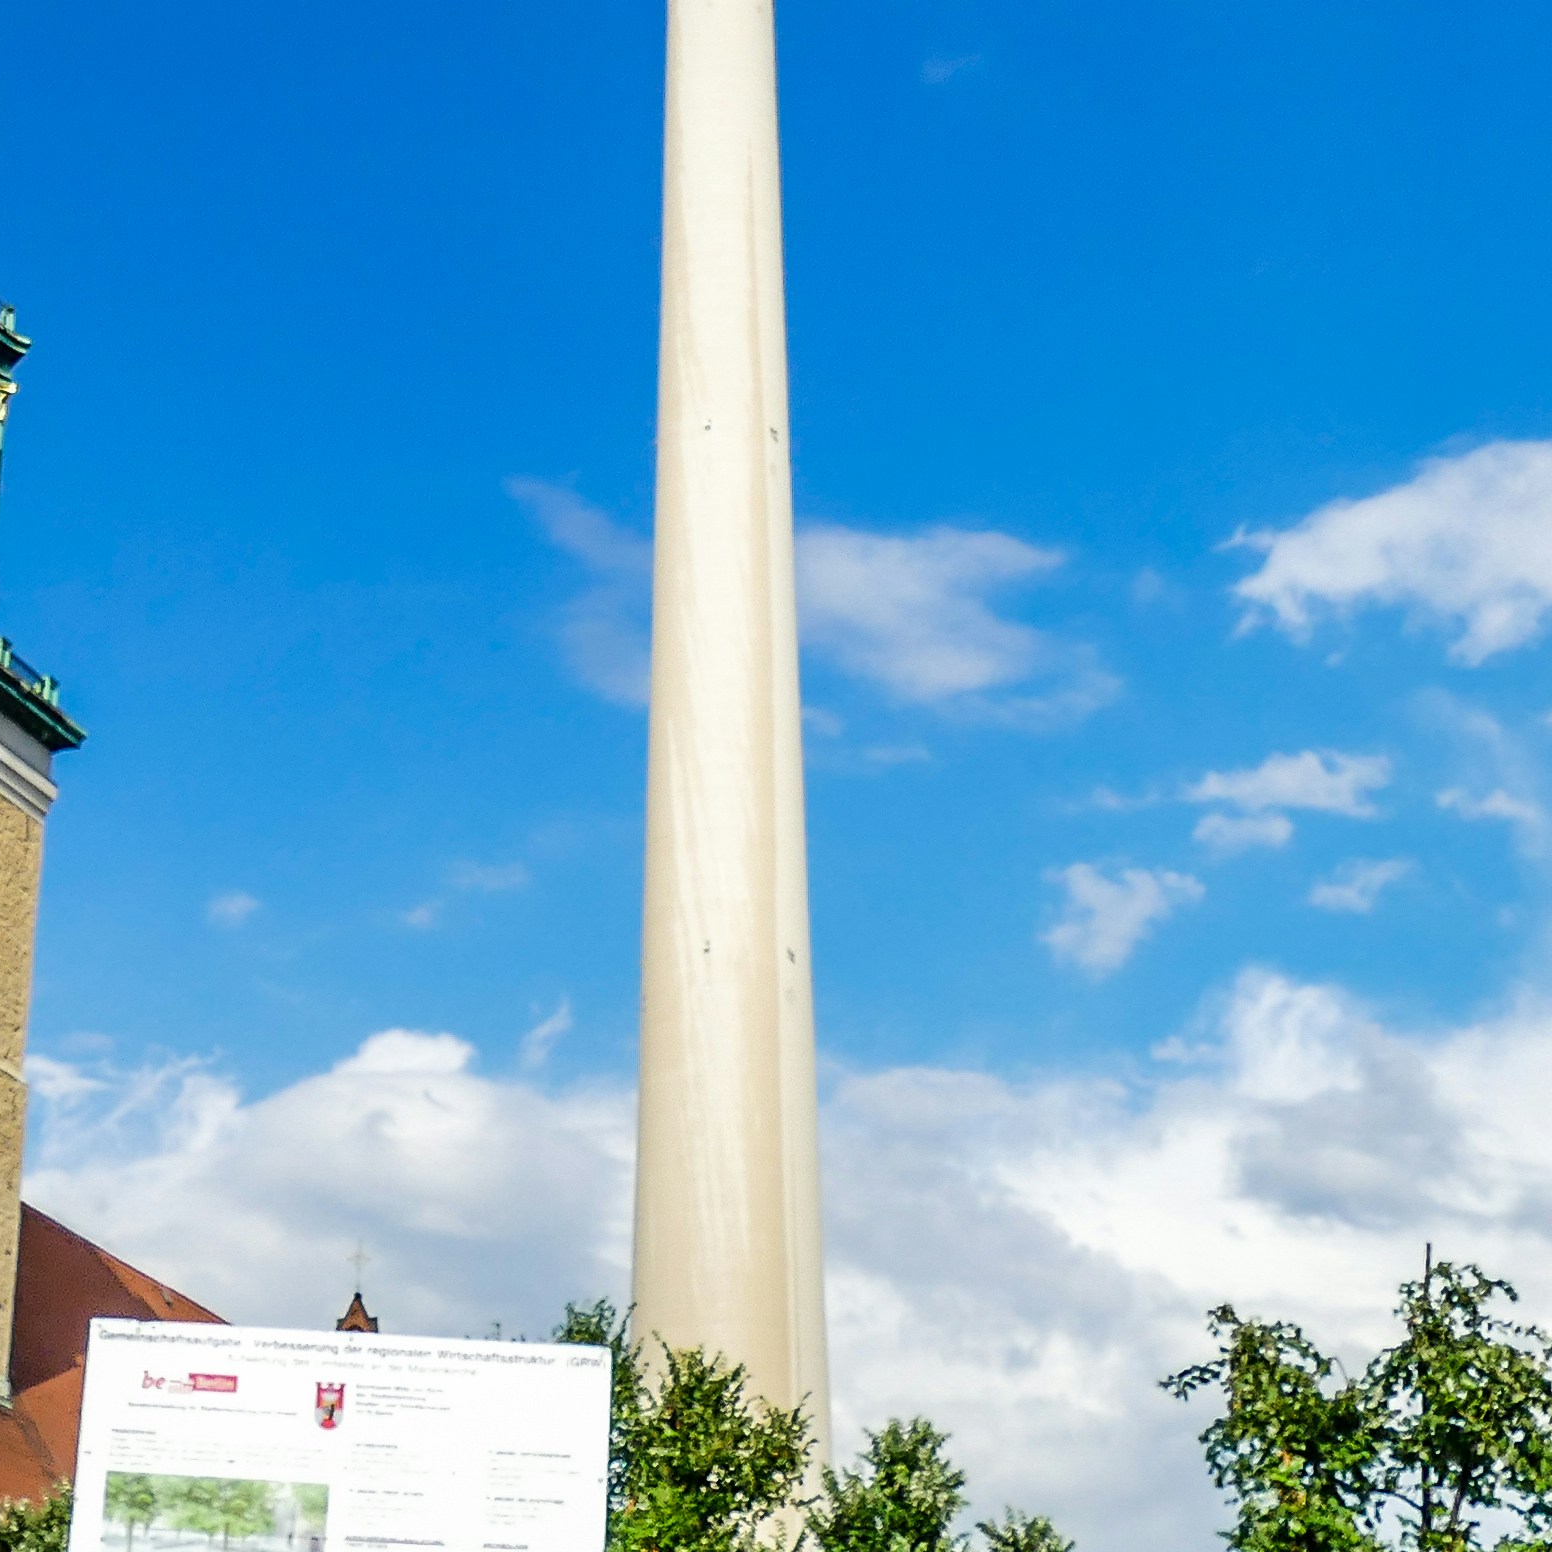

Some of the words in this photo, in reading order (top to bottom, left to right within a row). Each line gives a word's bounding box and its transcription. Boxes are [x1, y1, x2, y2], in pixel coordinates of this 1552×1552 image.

[343, 1344, 362, 1354] der
[367, 1345, 432, 1359] regionalen
[437, 1349, 556, 1366] Wirtschaftsstruktur
[140, 1369, 166, 1389] be
